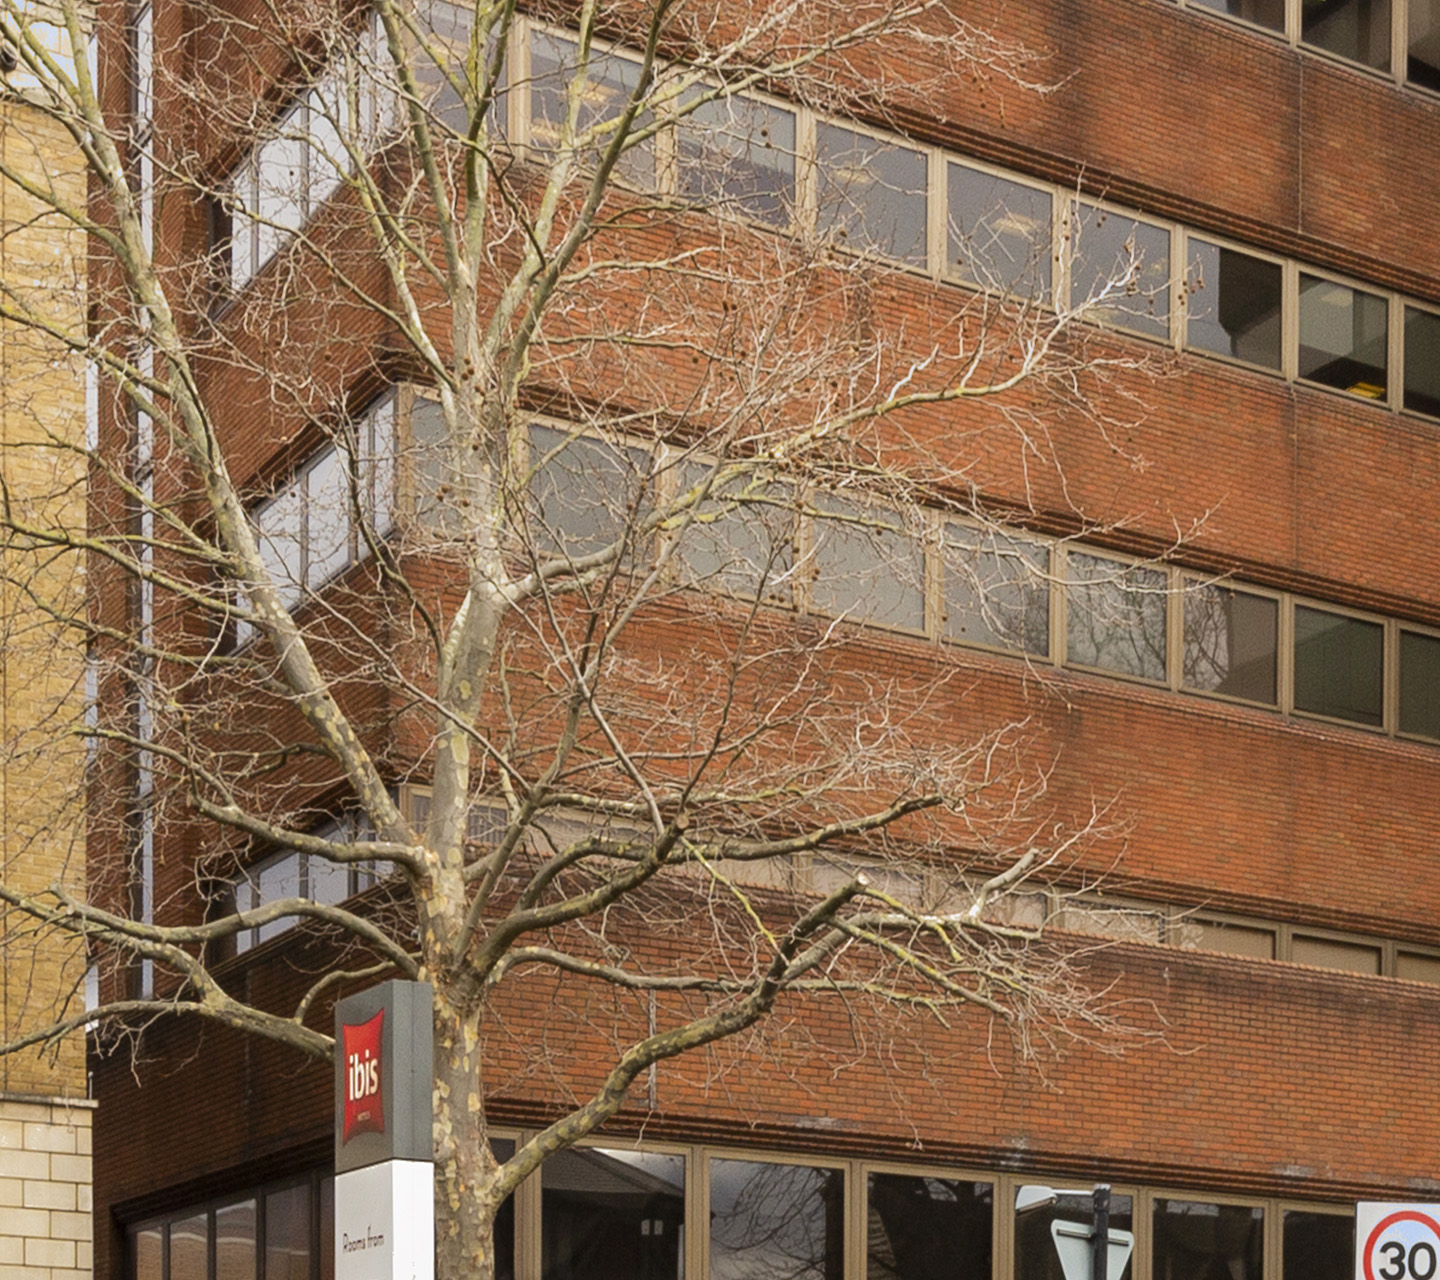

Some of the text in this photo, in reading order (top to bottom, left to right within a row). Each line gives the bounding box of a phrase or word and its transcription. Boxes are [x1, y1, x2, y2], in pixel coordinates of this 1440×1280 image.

[349, 1049, 379, 1100] ibis
[343, 1224, 384, 1253] Rooms from
